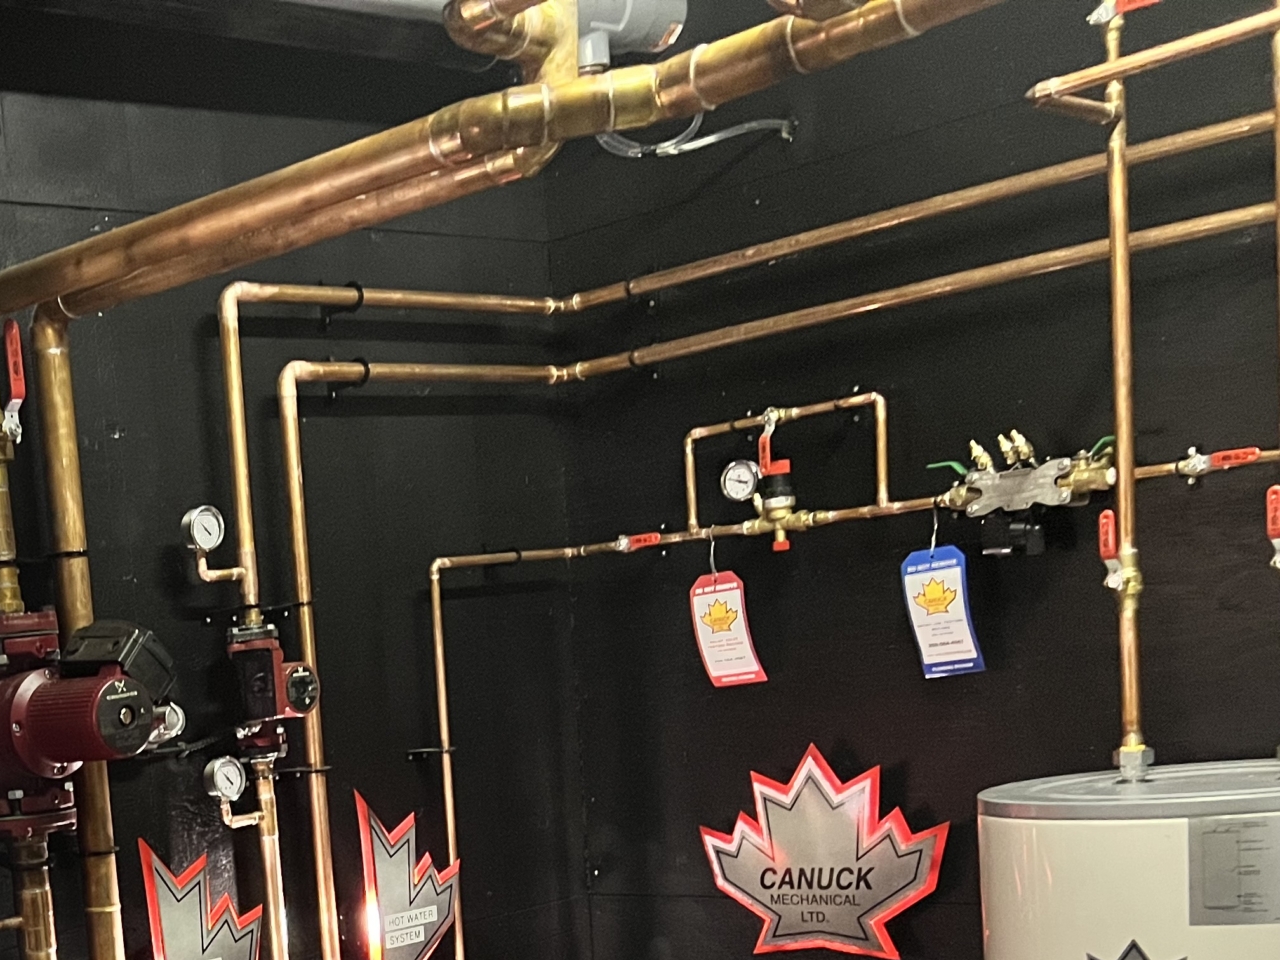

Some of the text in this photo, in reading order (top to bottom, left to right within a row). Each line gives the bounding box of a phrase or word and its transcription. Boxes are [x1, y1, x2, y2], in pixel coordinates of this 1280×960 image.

[759, 866, 875, 891] CANUCK
[770, 893, 861, 907] MECHANICAL
[388, 909, 433, 927] HOT WATER
[390, 930, 420, 945] SYSTEM
